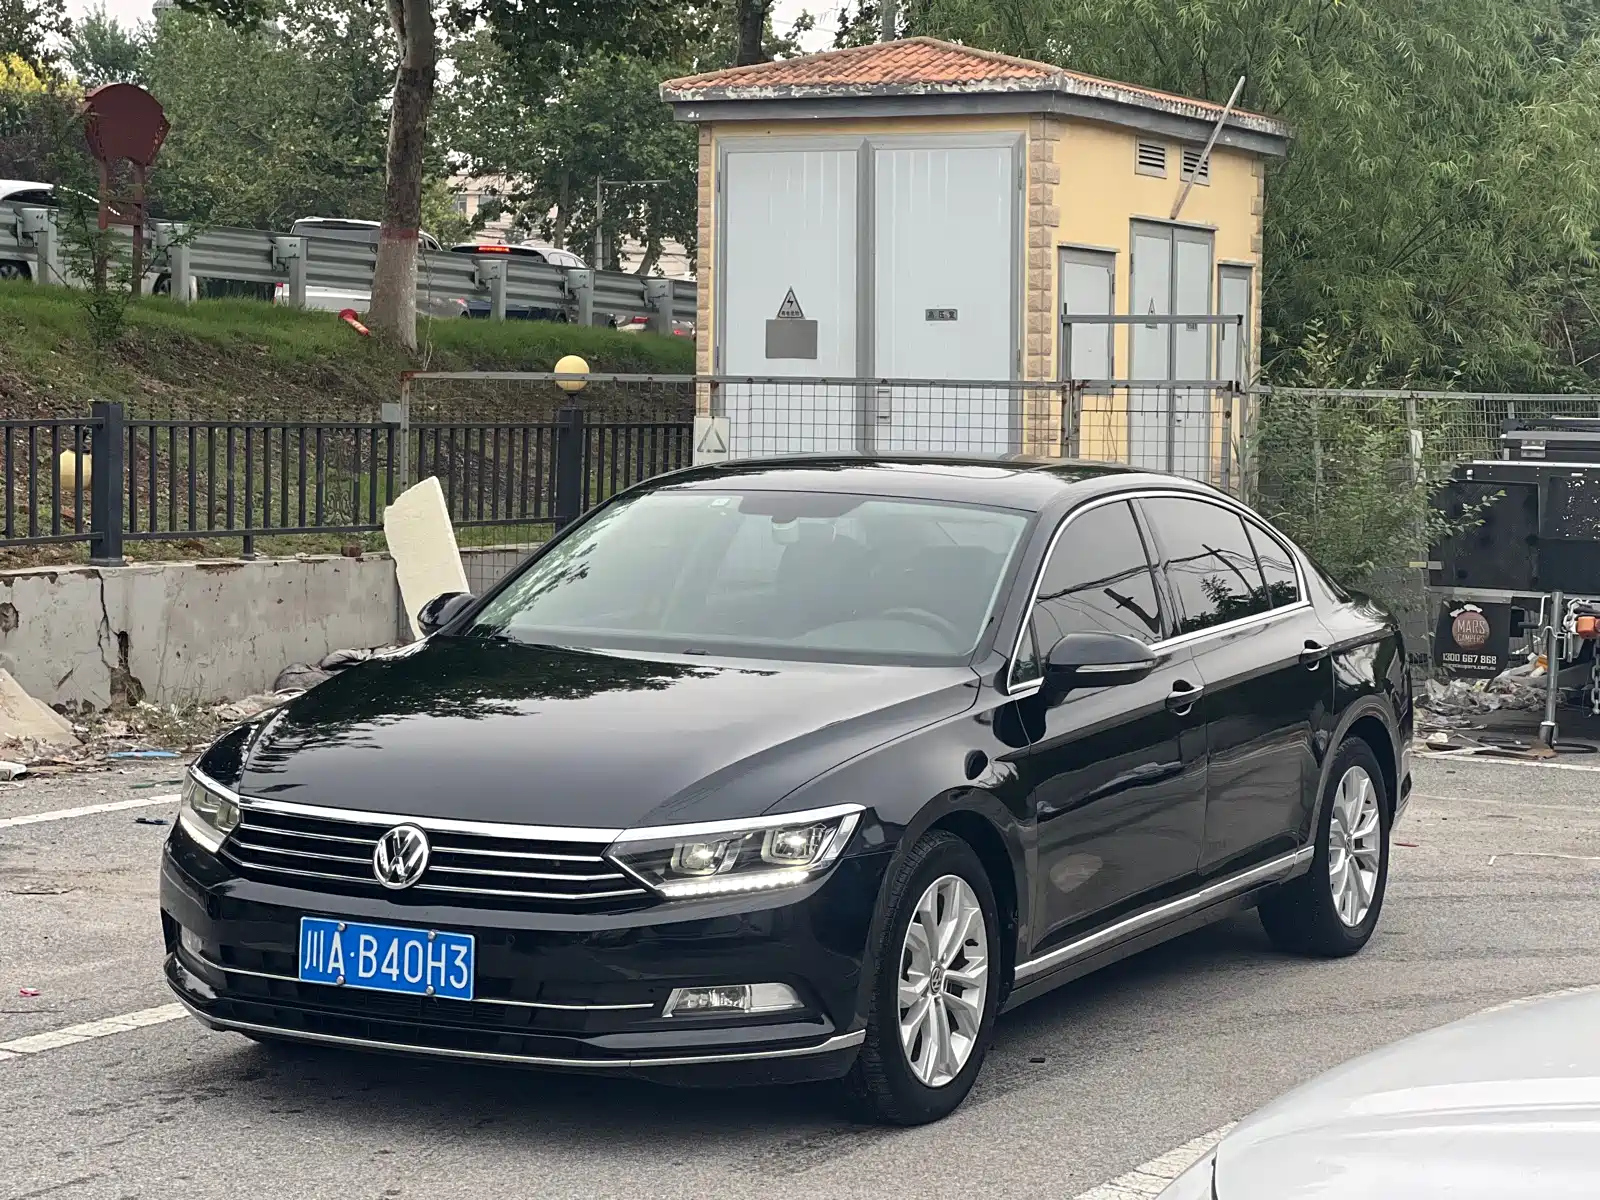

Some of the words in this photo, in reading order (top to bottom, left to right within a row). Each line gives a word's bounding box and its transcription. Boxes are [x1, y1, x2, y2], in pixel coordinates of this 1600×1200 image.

[1457, 620, 1485, 634] MARS
[1442, 652, 1460, 662] 1300
[1462, 653, 1478, 663] 667
[1480, 655, 1497, 665] 868
